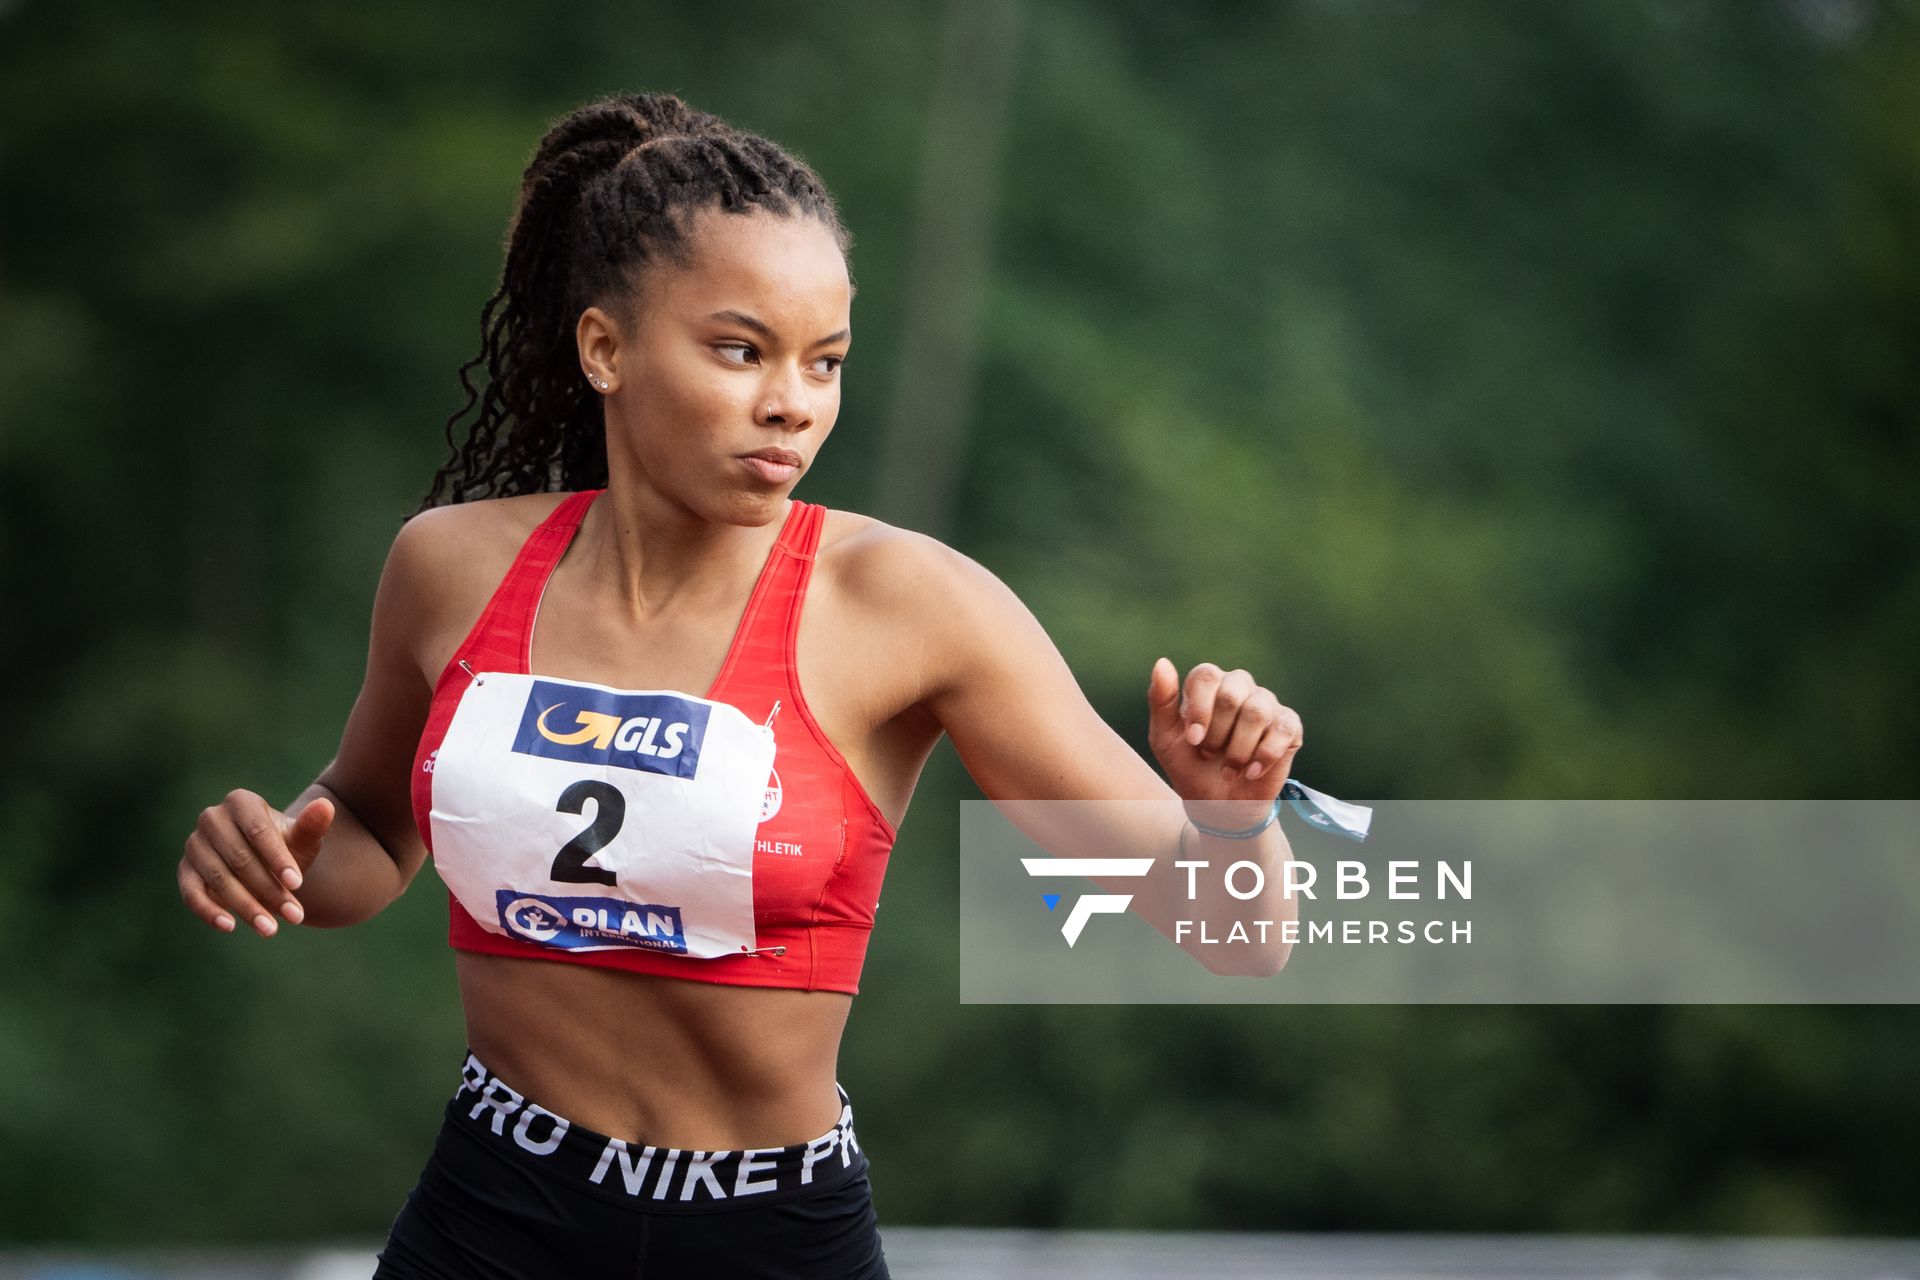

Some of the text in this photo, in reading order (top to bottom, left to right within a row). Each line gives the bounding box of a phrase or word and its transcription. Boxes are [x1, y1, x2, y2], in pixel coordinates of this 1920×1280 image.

[613, 717, 690, 759] GLS
[551, 780, 626, 886] 2
[572, 907, 674, 937] PLAN
[456, 1054, 859, 1201] PRO NIKE PR
